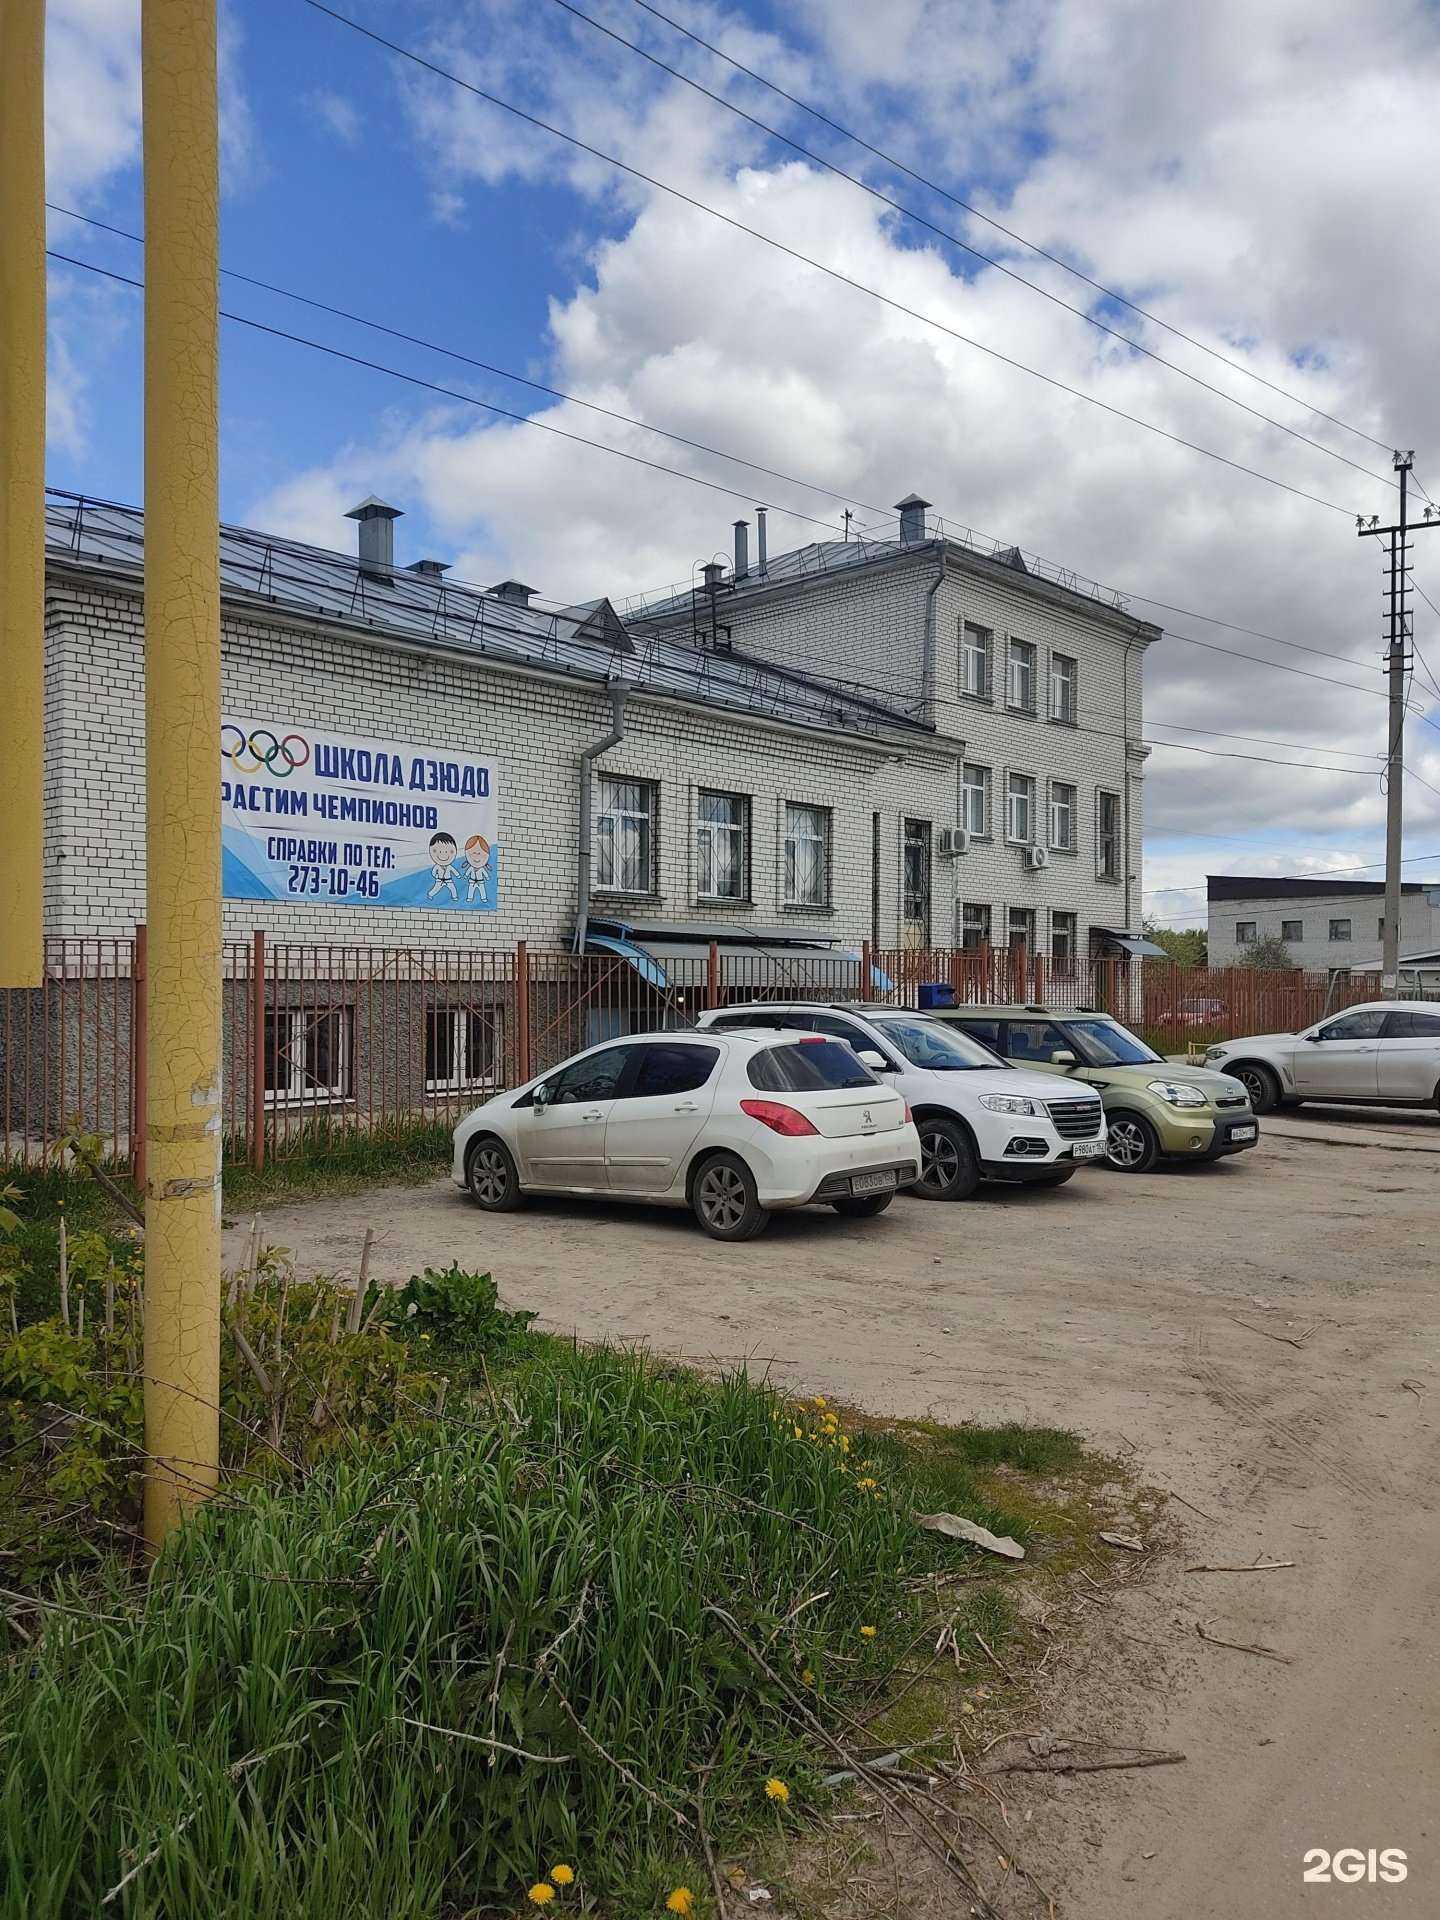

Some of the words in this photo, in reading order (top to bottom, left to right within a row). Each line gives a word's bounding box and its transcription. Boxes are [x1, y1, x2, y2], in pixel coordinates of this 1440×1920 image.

[314, 743, 404, 787] ШКОЛА
[408, 758, 490, 798] ДЗЮДО
[312, 796, 438, 830] ЧЕМПИОНОВ
[267, 836, 338, 865] СПРАВКИ
[343, 843, 363, 867] ПО
[366, 845, 396, 869] ТЕЛ:
[288, 865, 380, 897] 273-10-46
